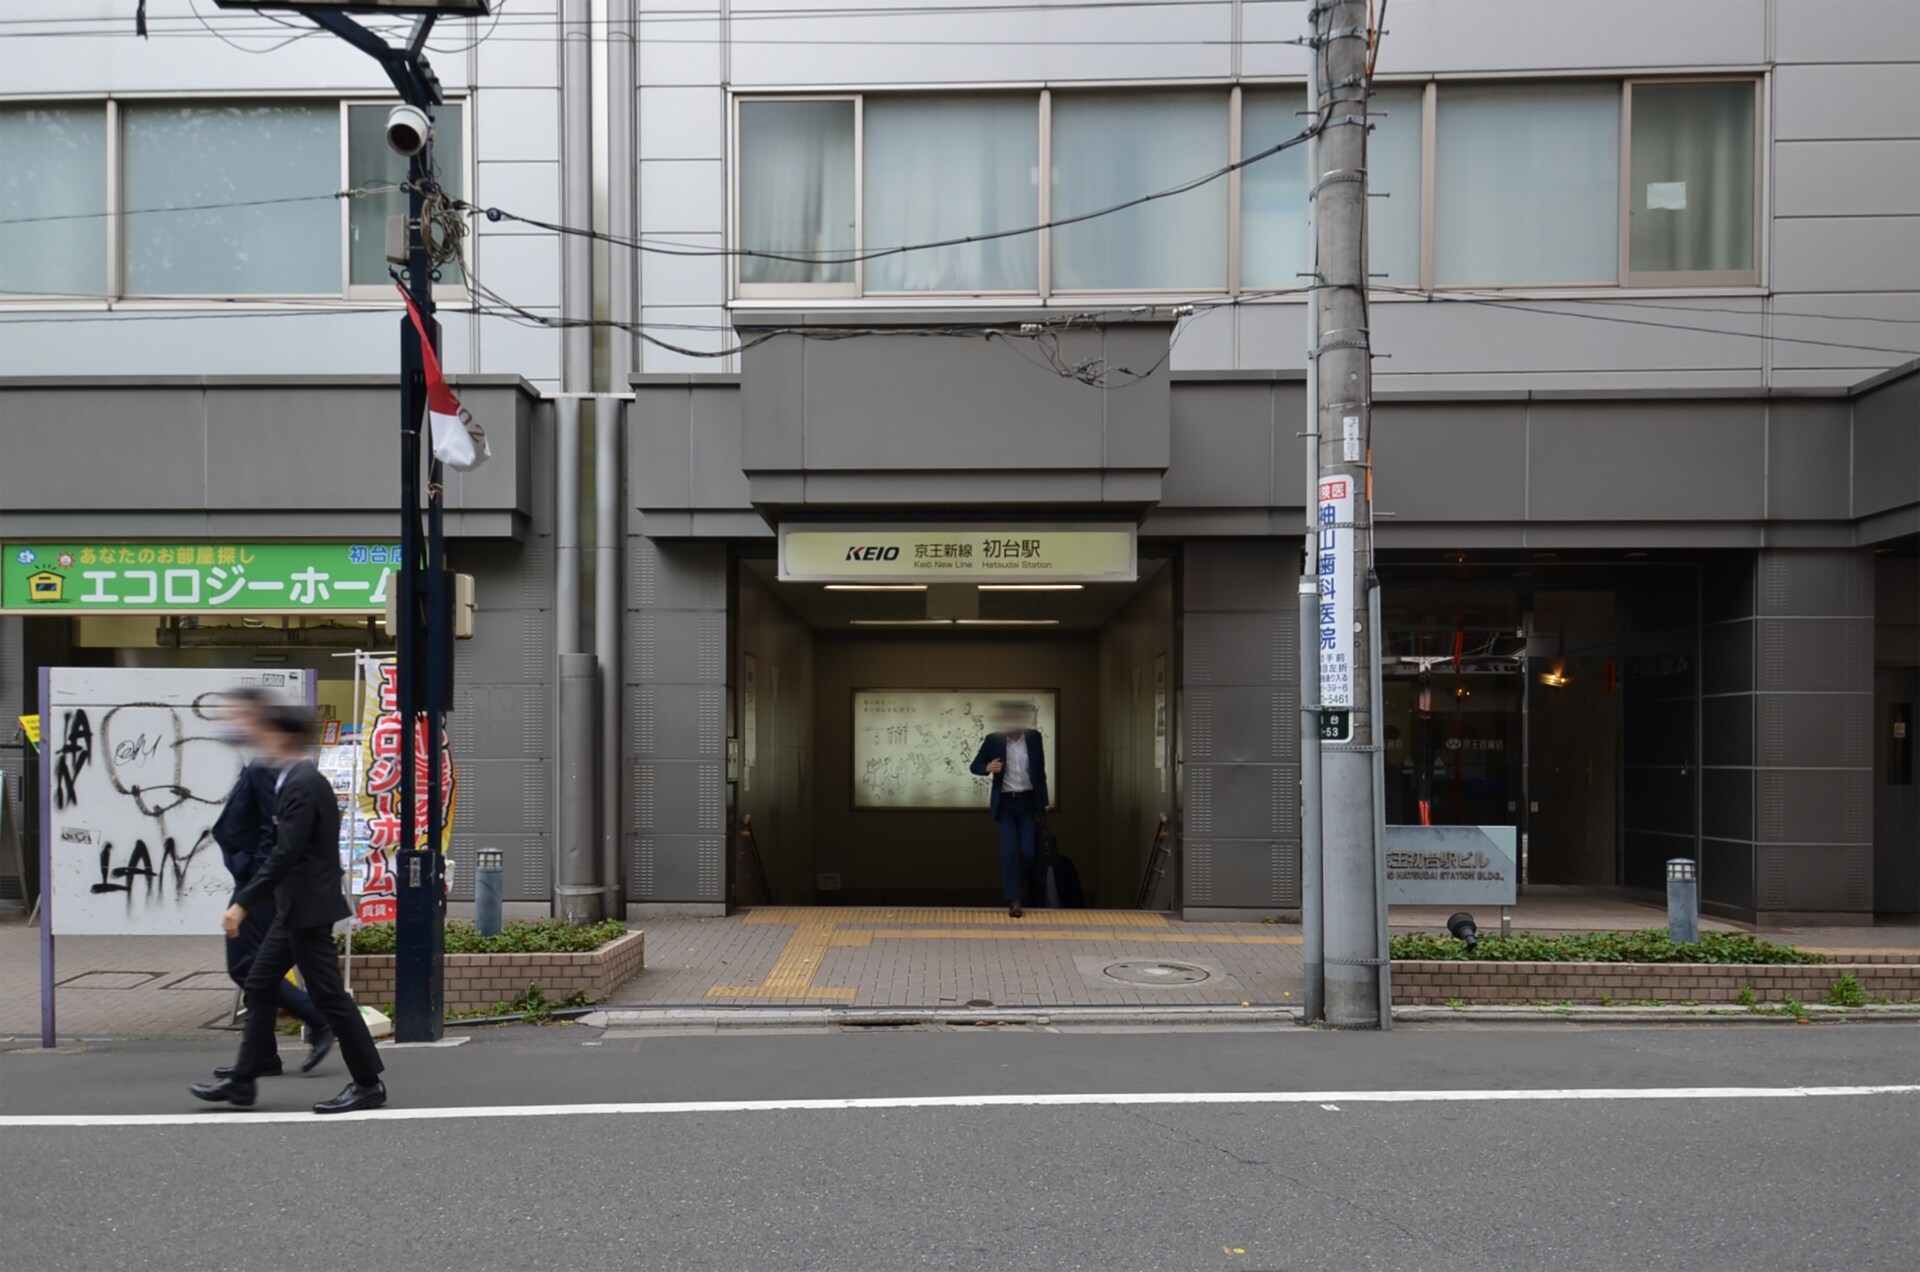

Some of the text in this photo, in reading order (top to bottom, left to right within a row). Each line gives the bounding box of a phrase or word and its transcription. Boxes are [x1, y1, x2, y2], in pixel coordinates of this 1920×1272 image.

[80, 547, 255, 565] あなたのお部屋探し
[845, 539, 1041, 561] KEIO 京王新線 初台駅
[934, 561, 953, 569] New
[955, 561, 972, 569] Line
[982, 560, 1019, 569] Hatsudai
[1022, 560, 1053, 569] Station
[1396, 871, 1438, 880] HATSUDAI
[1440, 871, 1475, 880] STATION
